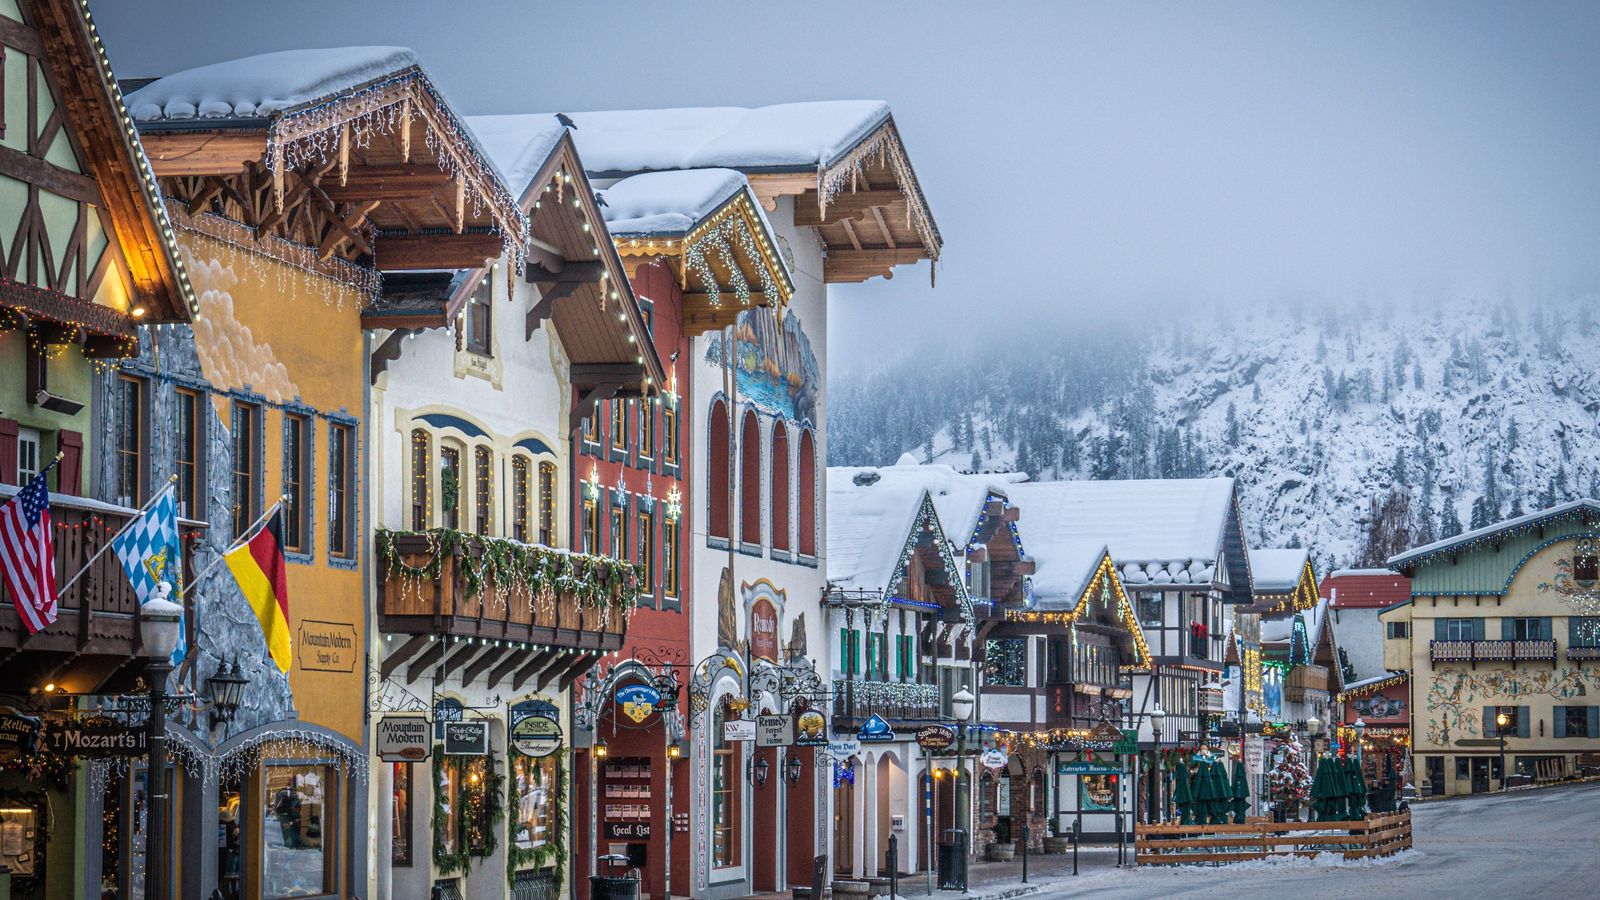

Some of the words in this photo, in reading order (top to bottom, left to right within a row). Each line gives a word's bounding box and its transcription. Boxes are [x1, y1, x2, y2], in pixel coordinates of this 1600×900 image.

[302, 629, 330, 648] Mountain
[330, 631, 352, 649] Modern
[383, 722, 425, 734] Mountain
[524, 721, 549, 729] INSIDE
[759, 717, 788, 729] Remedy
[386, 732, 424, 744] Modern
[917, 727, 938, 739] Studio
[938, 728, 952, 739] 1890
[64, 730, 136, 751] Mozart's
[612, 824, 633, 837] Local
